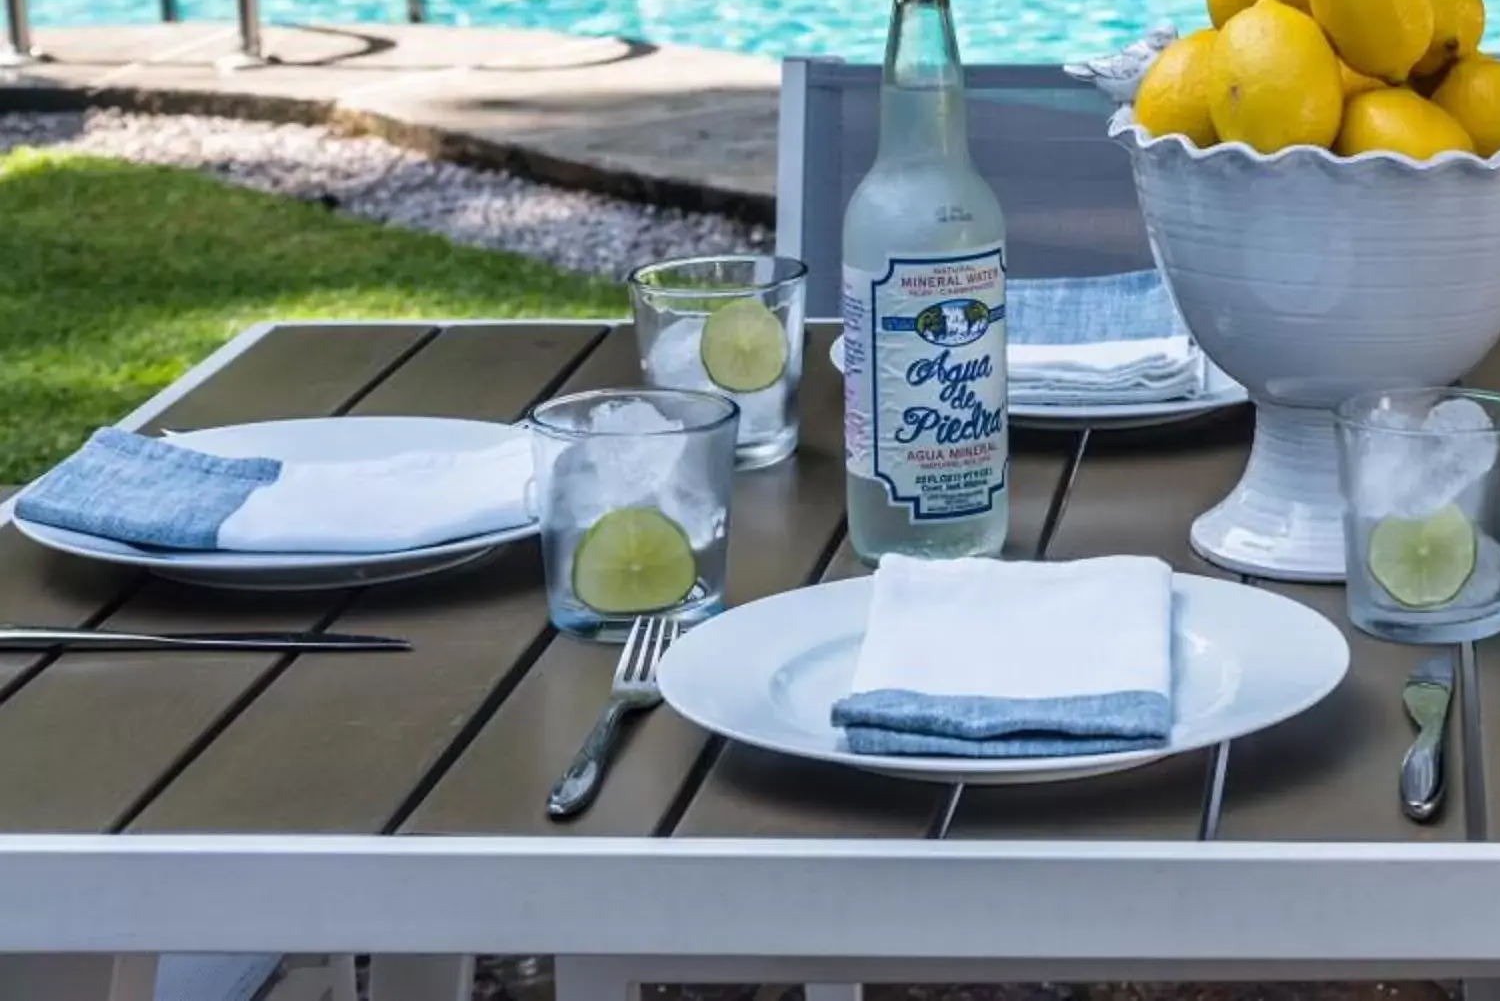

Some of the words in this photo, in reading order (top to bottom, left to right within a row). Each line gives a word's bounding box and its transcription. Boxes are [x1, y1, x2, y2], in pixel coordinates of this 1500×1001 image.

[901, 275, 962, 288] MINERAL
[966, 267, 999, 284] WATER
[906, 349, 993, 402] Agua
[950, 385, 978, 410] de
[895, 404, 1003, 444] Piedra
[907, 450, 944, 462] AGUA
